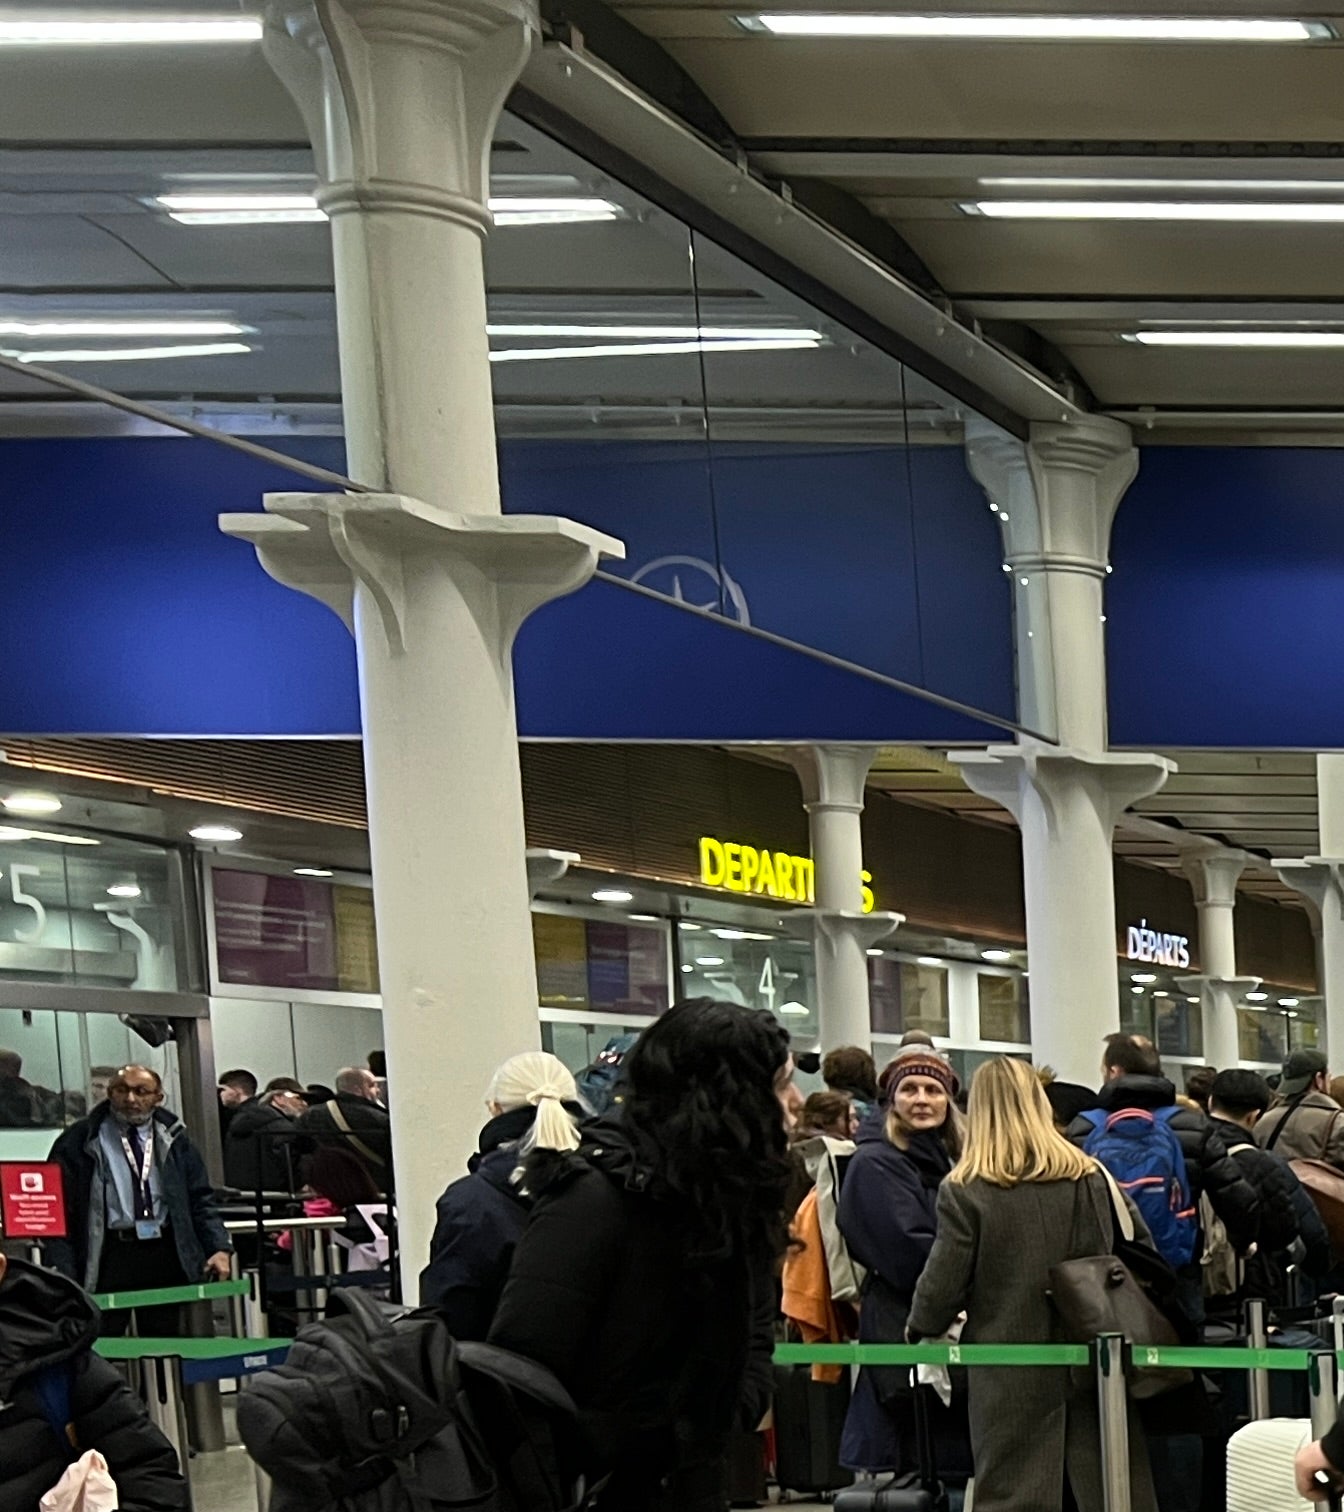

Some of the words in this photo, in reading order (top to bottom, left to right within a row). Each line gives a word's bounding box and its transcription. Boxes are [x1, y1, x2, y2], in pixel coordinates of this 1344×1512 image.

[10, 863, 47, 945] 5
[1127, 918, 1190, 968] DÉPARTS
[759, 957, 776, 1010] 4
